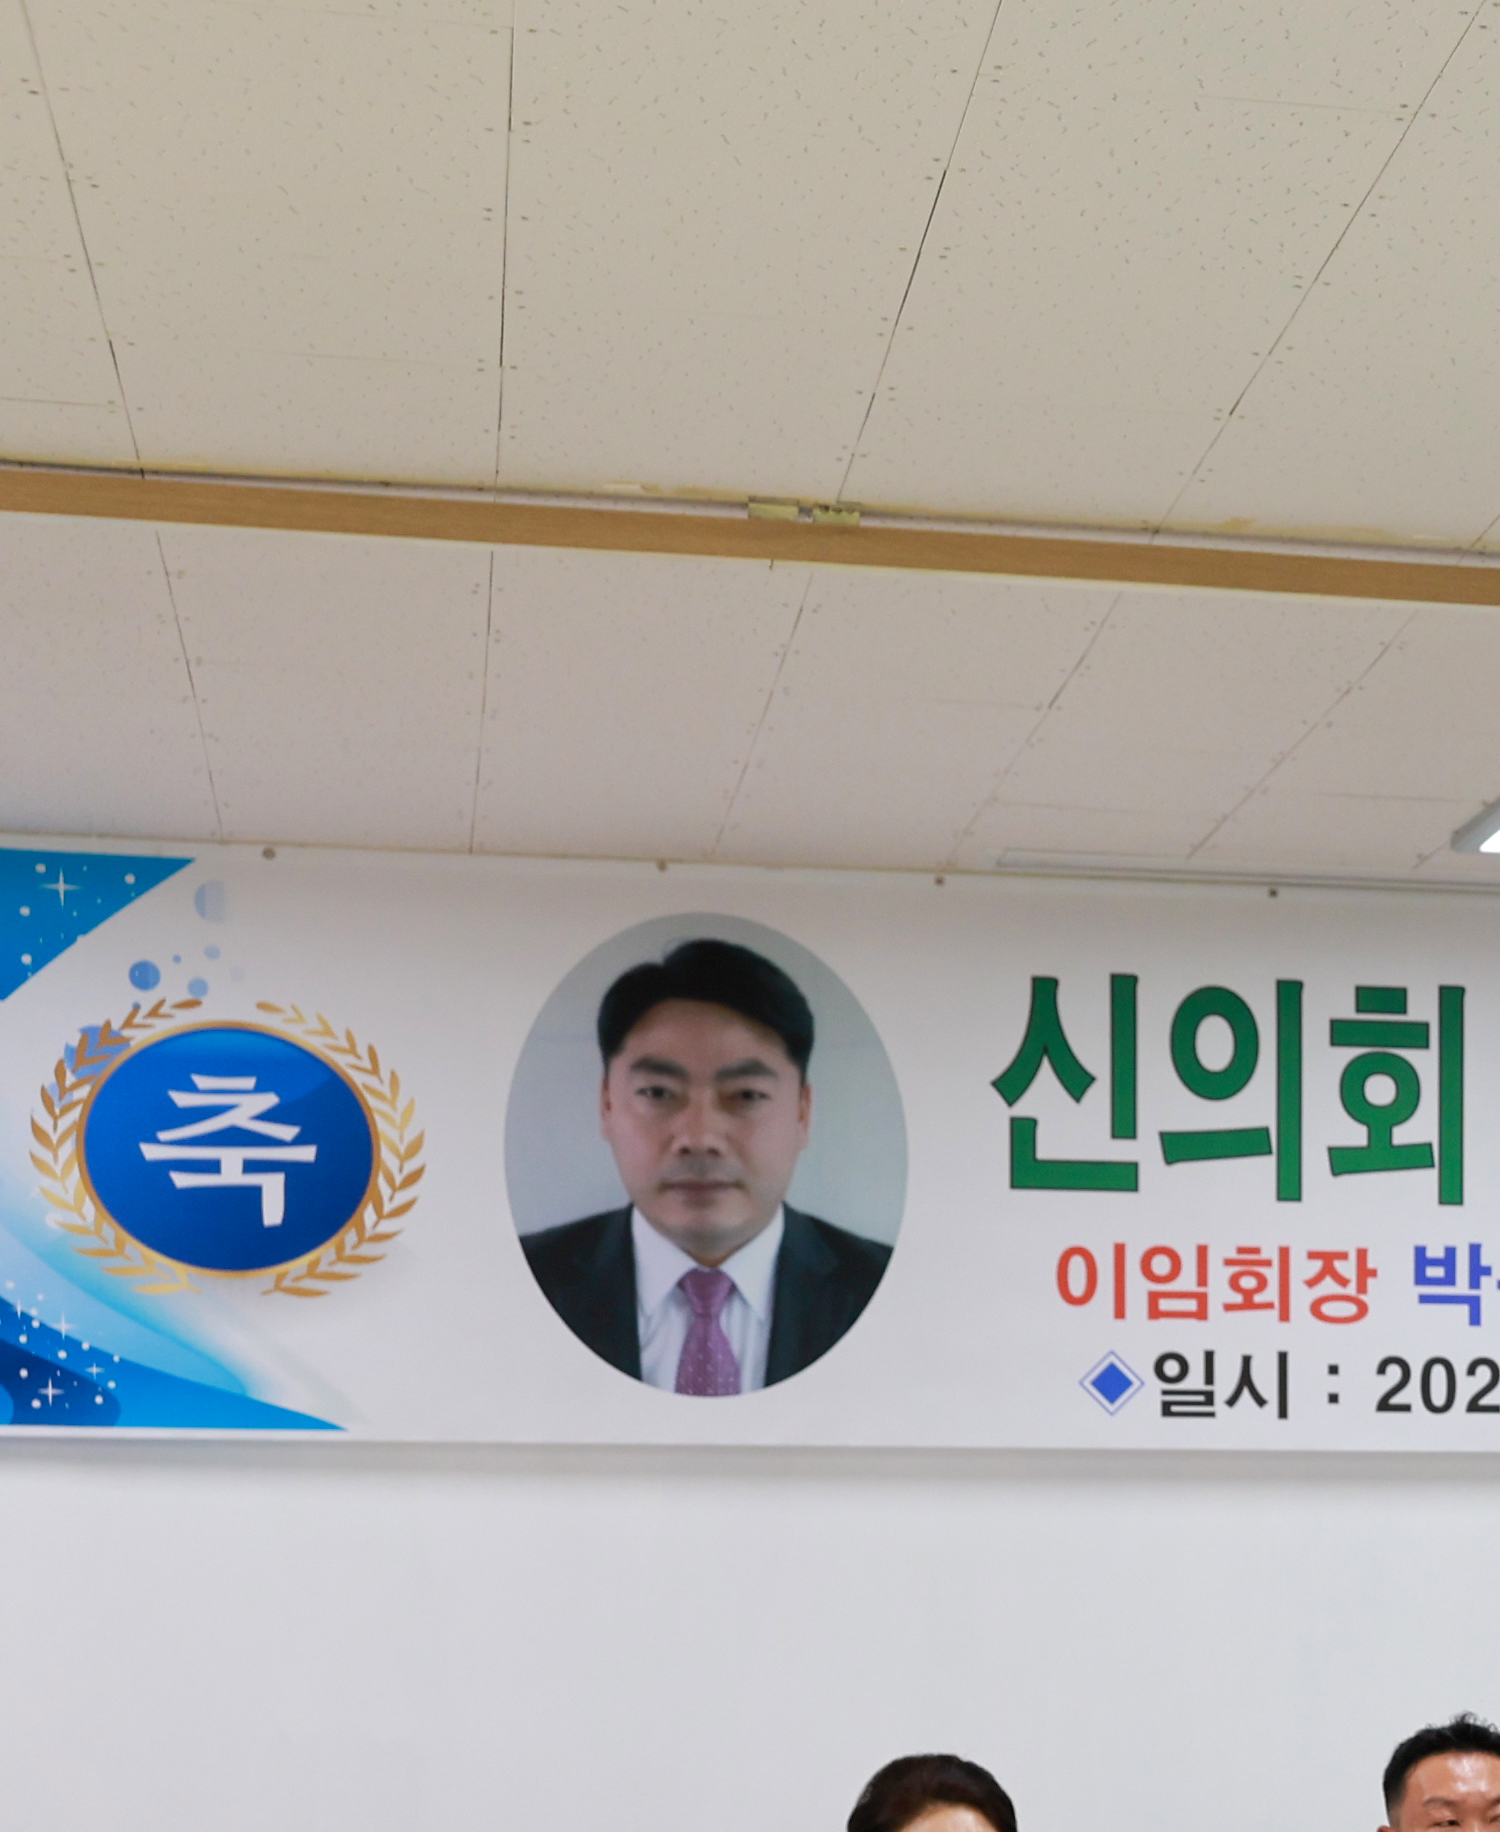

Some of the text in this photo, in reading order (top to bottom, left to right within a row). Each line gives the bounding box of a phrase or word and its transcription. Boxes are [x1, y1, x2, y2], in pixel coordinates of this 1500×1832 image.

[137, 1071, 319, 1228] 축
[990, 973, 1466, 1206] 신의회
[1055, 1242, 1379, 1326] 이임회장
[1152, 1349, 1290, 1420] 일시
